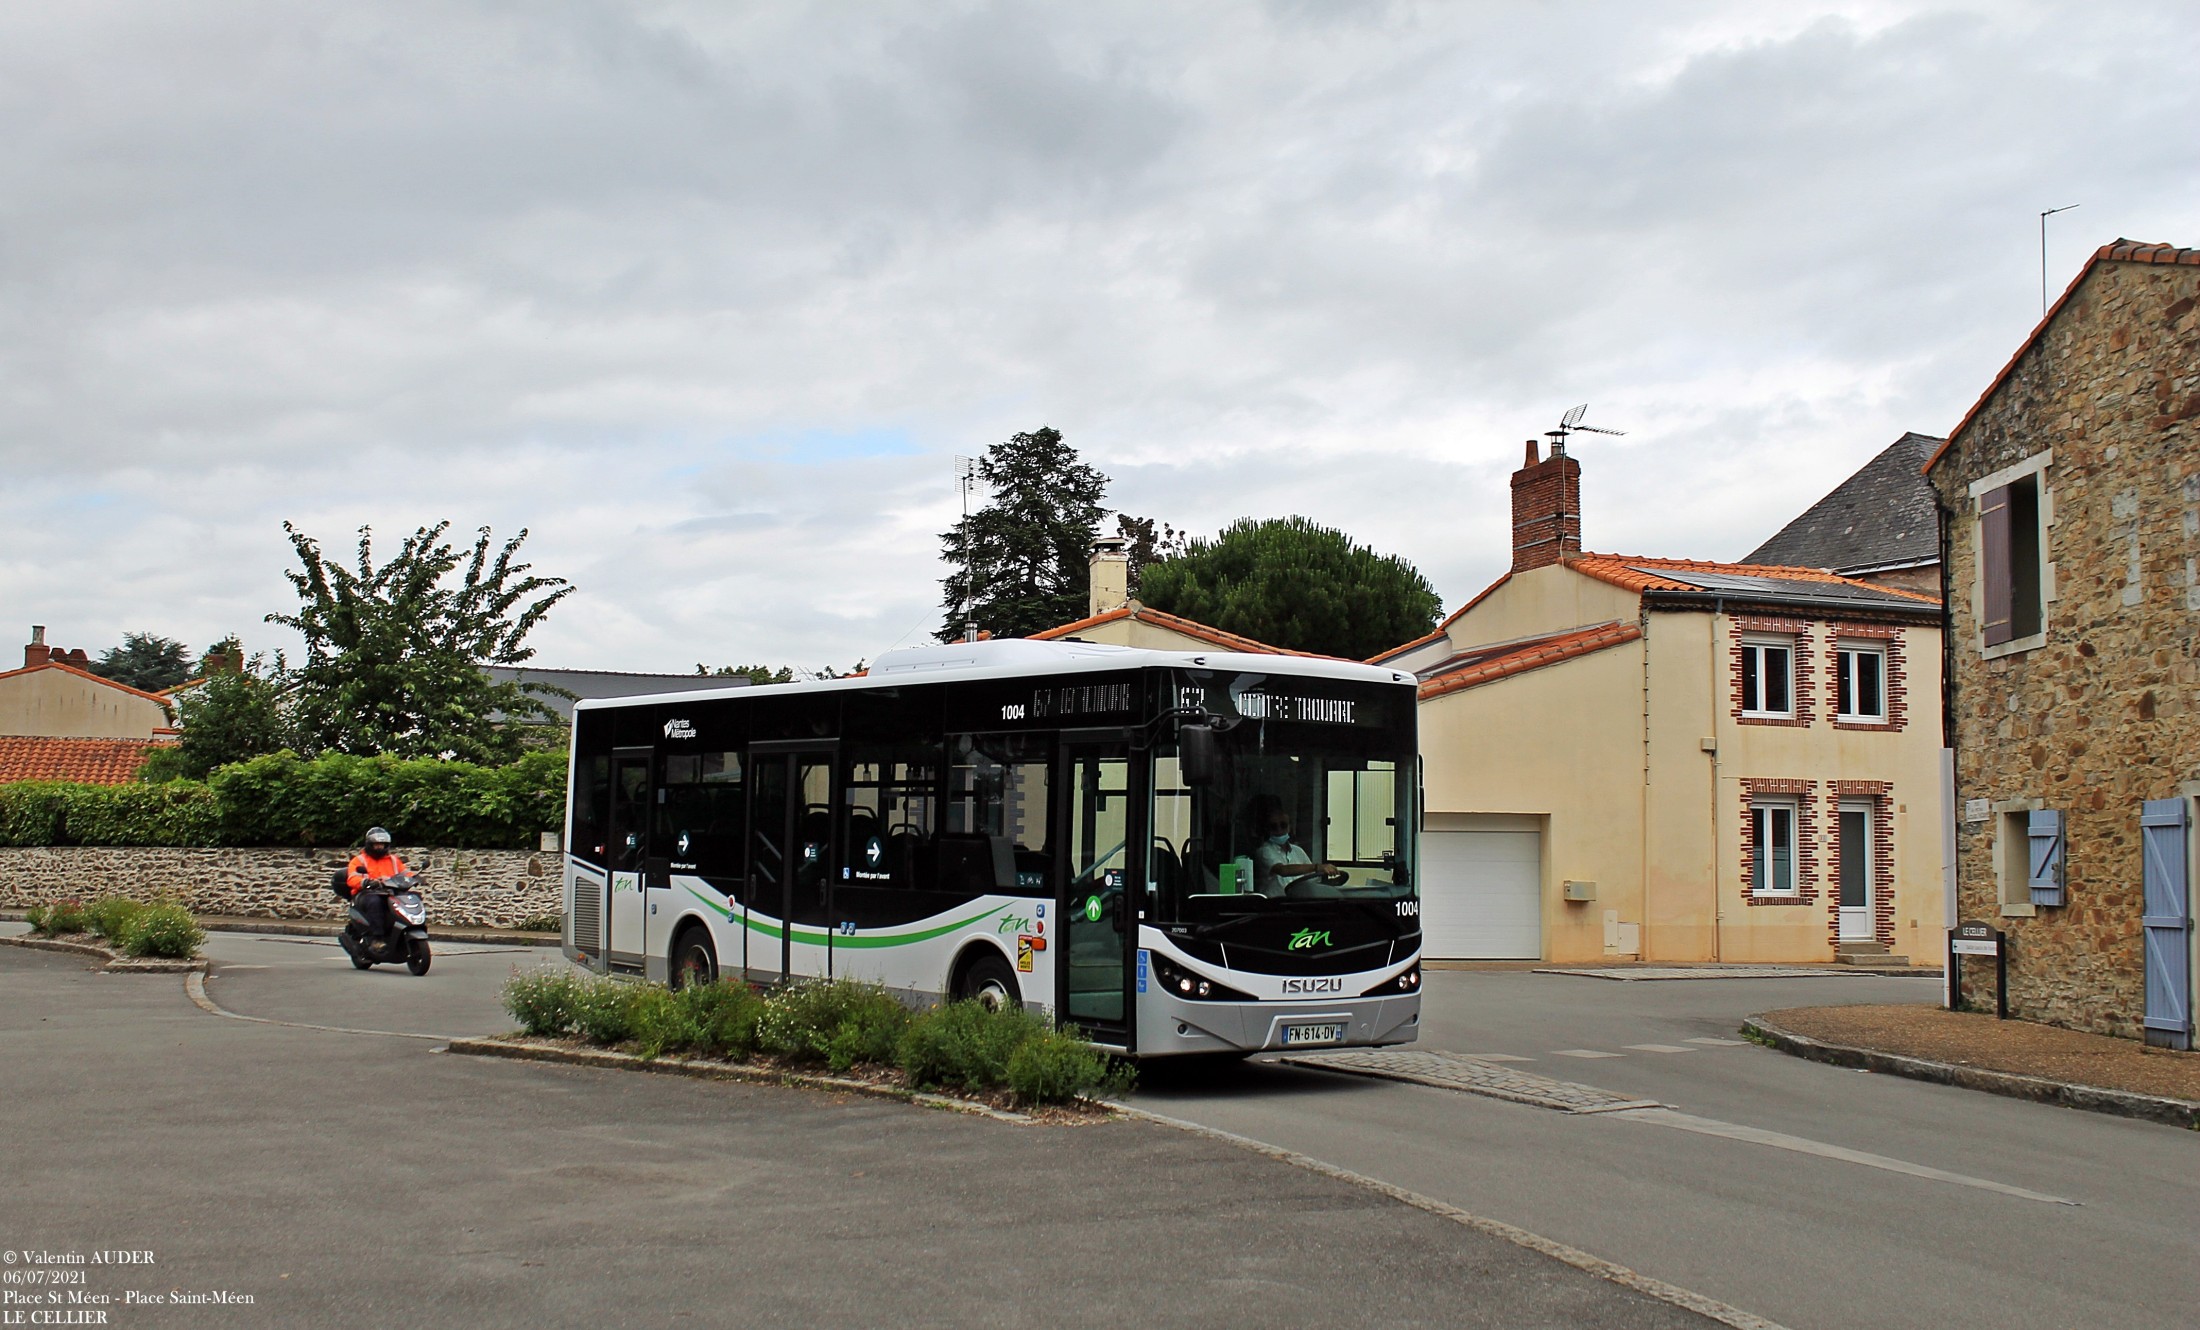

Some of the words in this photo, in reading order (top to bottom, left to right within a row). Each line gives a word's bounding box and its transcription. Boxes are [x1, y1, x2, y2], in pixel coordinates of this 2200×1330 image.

[1001, 704, 1025, 720] 1004
[1395, 900, 1419, 916] 1004
[998, 913, 1032, 934] tan
[1288, 927, 1334, 950] tan
[1282, 977, 1343, 994] ISUZU
